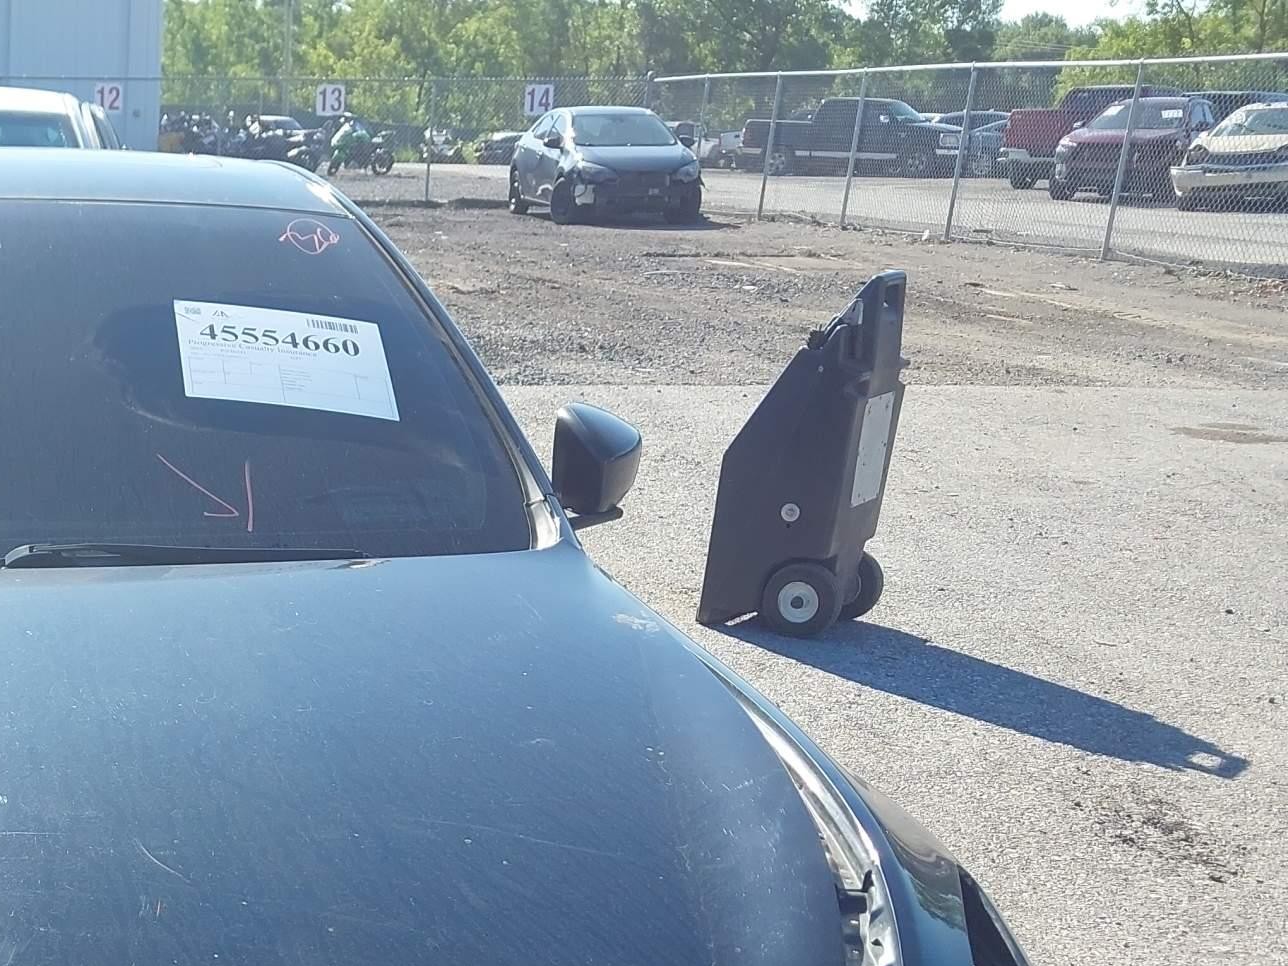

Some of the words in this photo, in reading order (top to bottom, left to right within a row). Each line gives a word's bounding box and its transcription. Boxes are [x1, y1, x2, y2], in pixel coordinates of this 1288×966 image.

[96, 86, 120, 110] 12
[319, 87, 342, 112] 13
[527, 87, 551, 112] 14
[200, 323, 360, 357] 45554660
